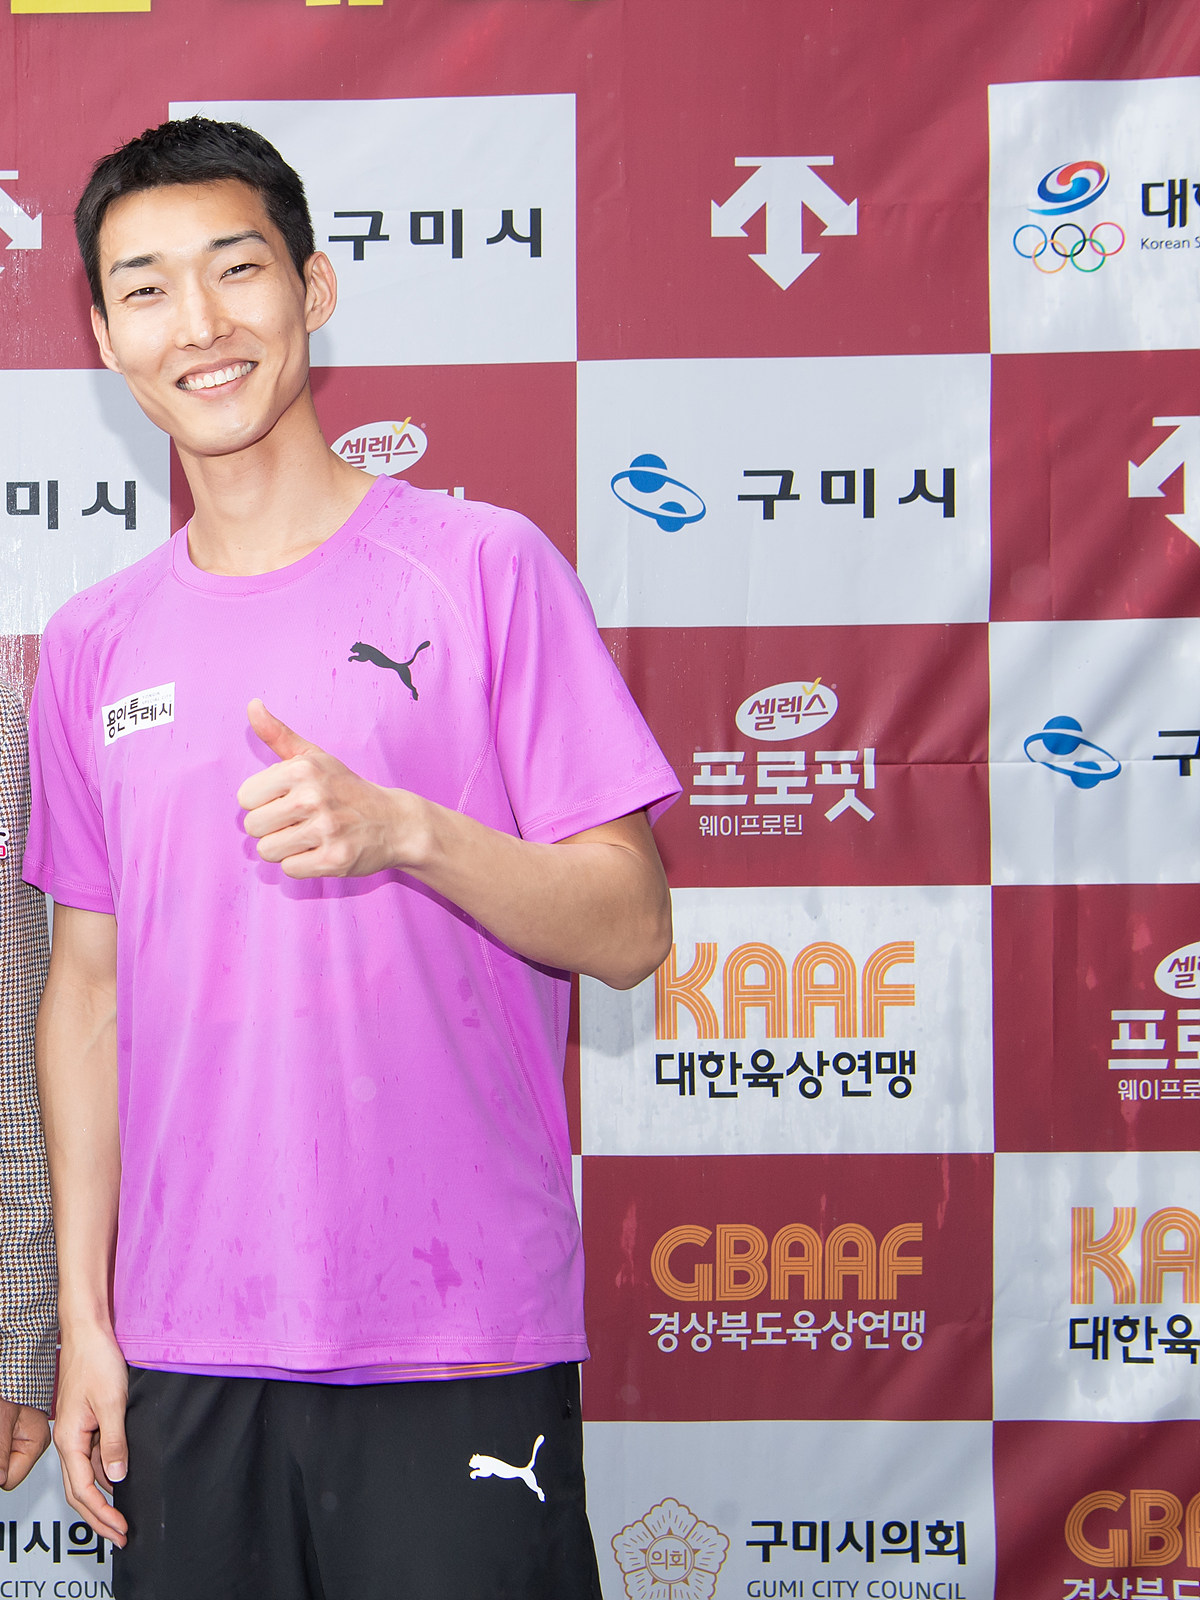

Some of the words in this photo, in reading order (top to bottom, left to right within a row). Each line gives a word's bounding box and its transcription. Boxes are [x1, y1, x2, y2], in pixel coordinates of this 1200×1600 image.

[1141, 178, 1200, 229] 대
[328, 208, 543, 261] 구미시
[1140, 237, 1191, 250] Korean
[339, 433, 418, 469] 셀렉스
[737, 468, 957, 521] 구미시
[106, 697, 172, 739] 용인특례시
[748, 694, 829, 731] 셀렉스
[689, 748, 876, 822] 프로핏
[699, 814, 803, 837] 웨이프로틴
[655, 941, 915, 1040] KAAF
[655, 1048, 916, 1099] 대한육상연맹
[650, 1222, 923, 1301] GBAAF
[648, 1310, 926, 1353] 경상북도육상연맹
[746, 1520, 967, 1565] 구미시의회
[1064, 1489, 1200, 1568] GB
[650, 1548, 688, 1571] 의회
[0, 1580, 46, 1598] CITY
[746, 1580, 804, 1598] GUMI
[811, 1580, 860, 1598] CITY
[867, 1580, 967, 1600] COUNCIL
